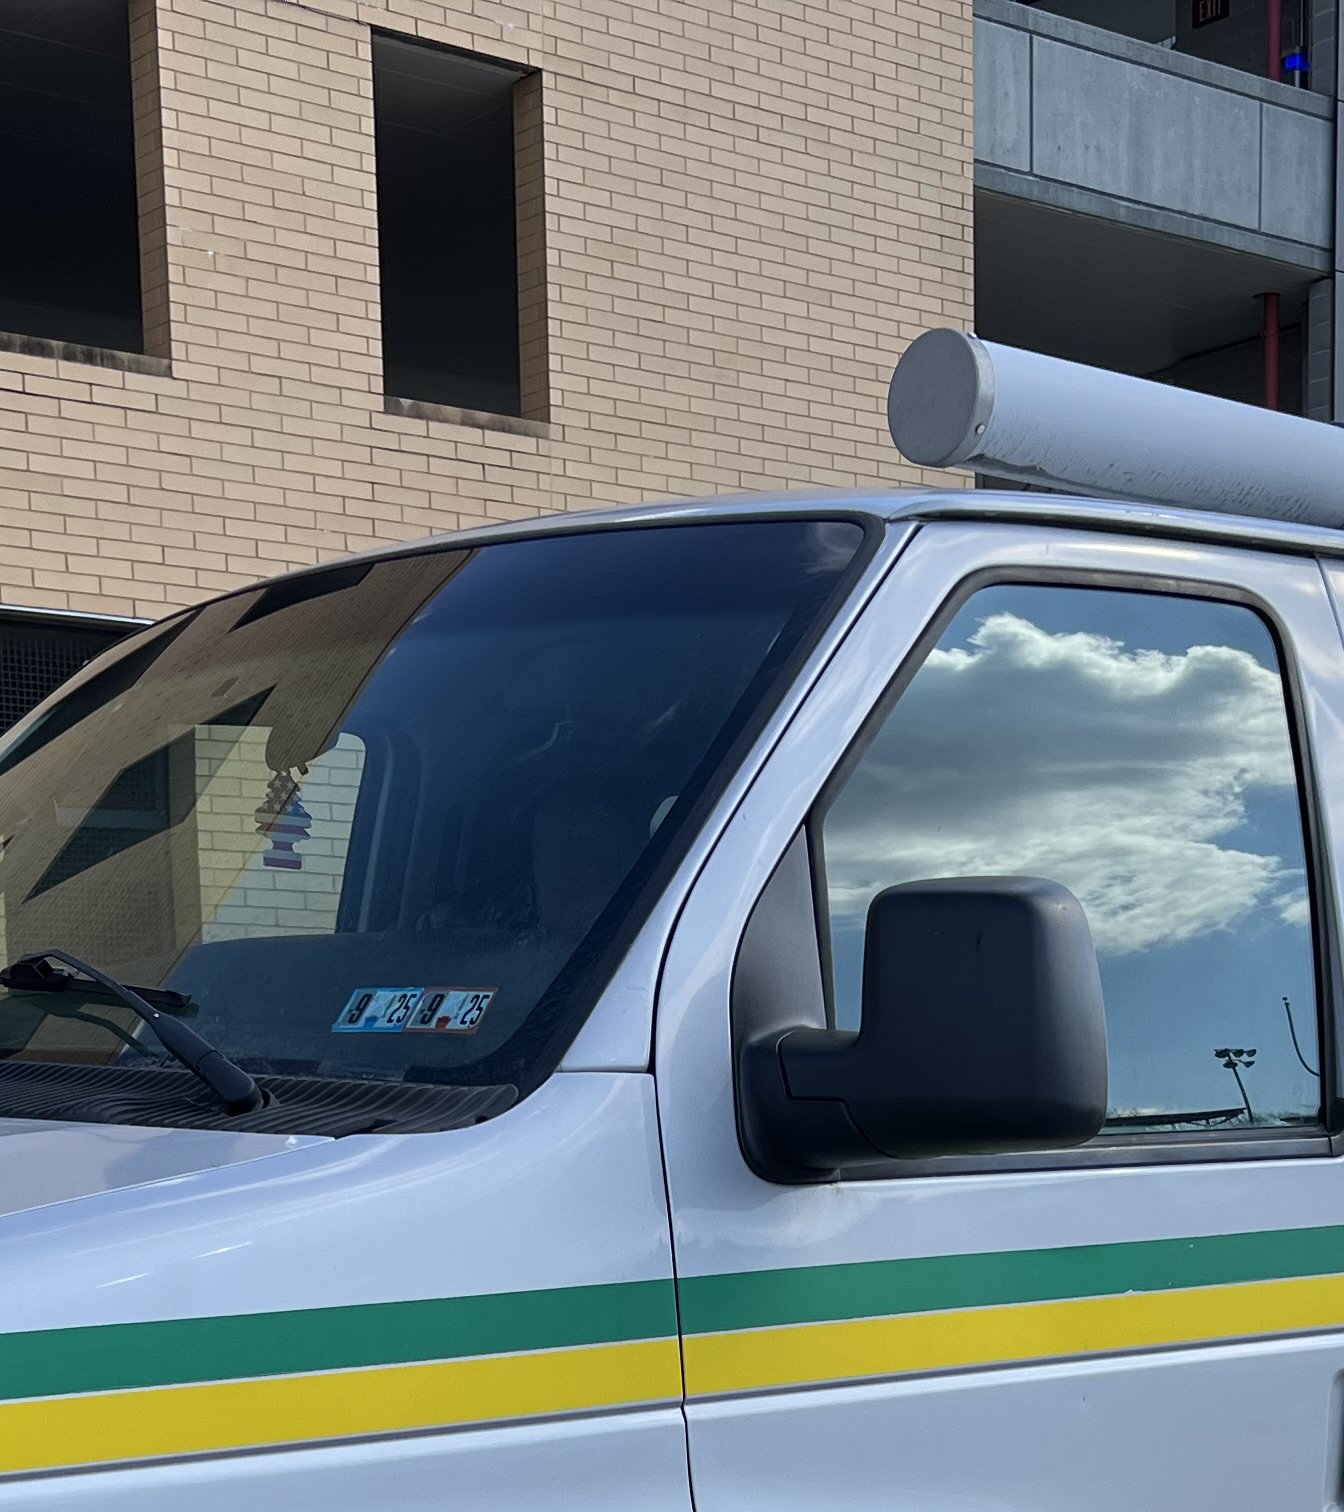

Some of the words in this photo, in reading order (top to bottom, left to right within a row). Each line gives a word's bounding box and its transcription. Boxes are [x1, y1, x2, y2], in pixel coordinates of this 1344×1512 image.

[347, 994, 373, 1024] 9
[386, 994, 418, 1024] 25
[420, 994, 445, 1024] 9
[459, 995, 490, 1025] 25
